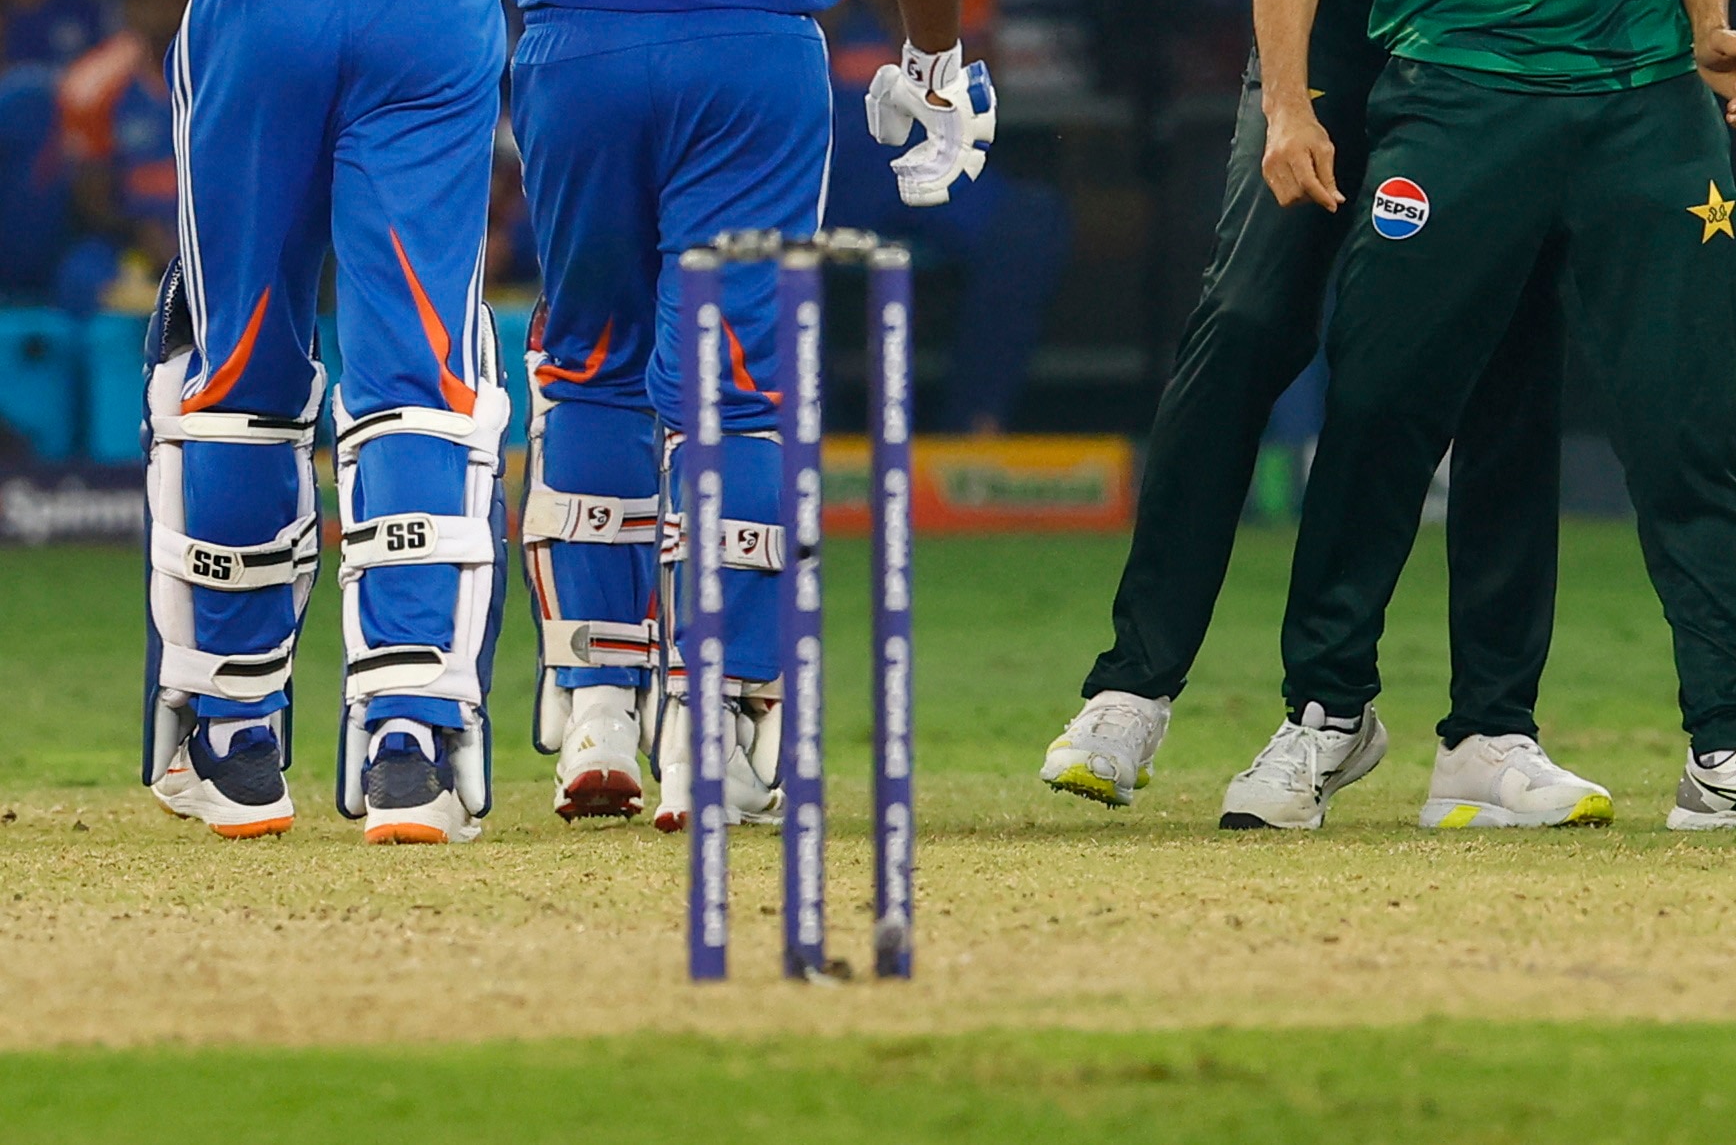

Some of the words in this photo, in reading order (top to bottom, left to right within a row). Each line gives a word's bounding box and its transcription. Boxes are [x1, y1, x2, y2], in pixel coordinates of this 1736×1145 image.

[1376, 198, 1425, 222] PEPSI
[386, 521, 426, 552] SS
[193, 549, 233, 581] SS
